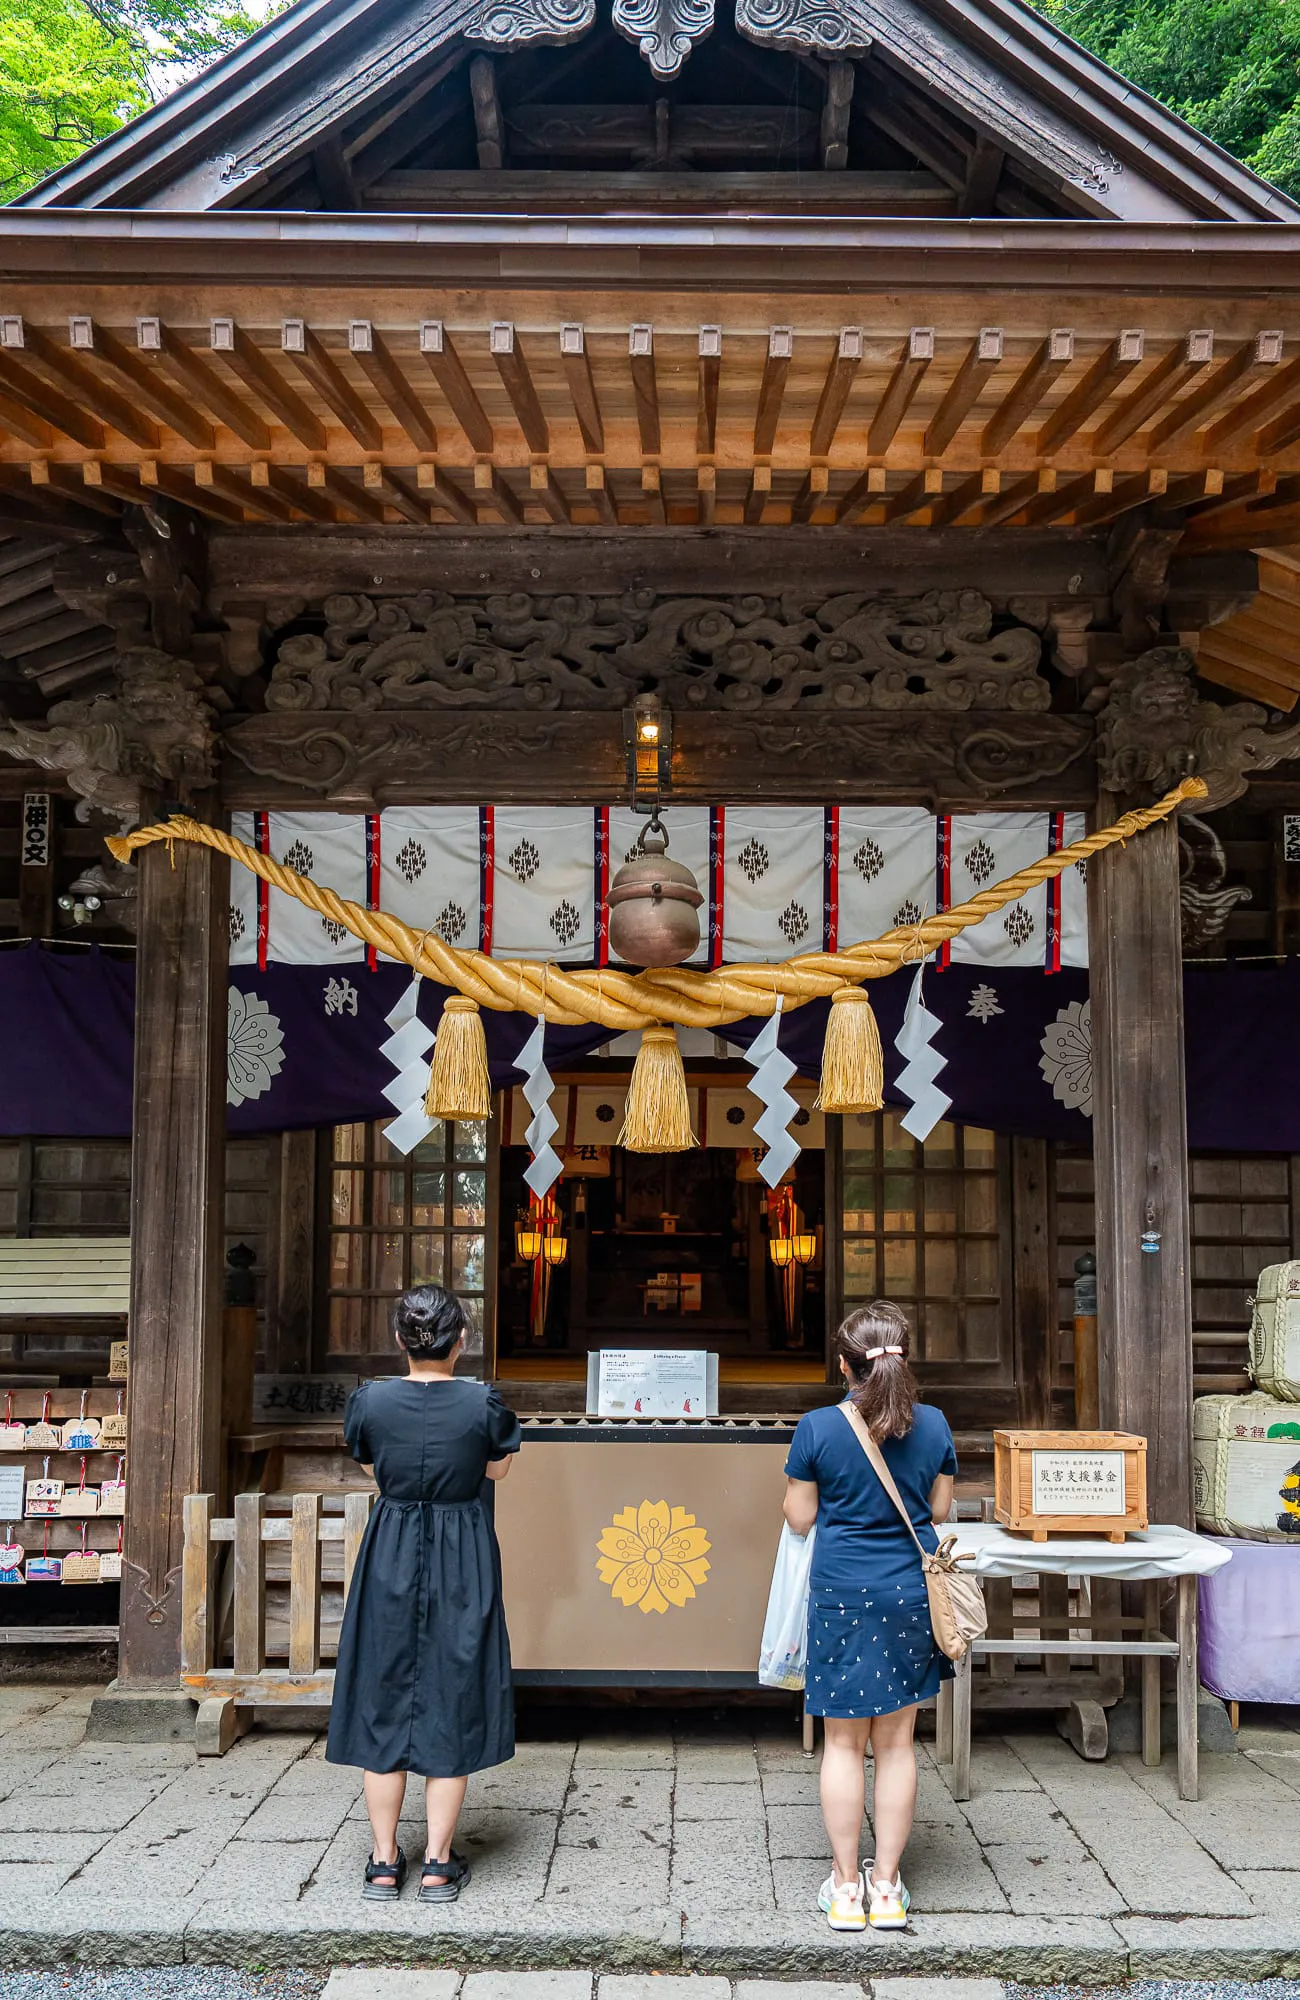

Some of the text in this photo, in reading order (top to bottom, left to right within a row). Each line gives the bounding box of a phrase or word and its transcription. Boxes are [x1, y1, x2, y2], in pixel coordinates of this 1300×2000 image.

[323, 977, 358, 1016] 納
[965, 984, 1005, 1024] 奉
[1233, 1424, 1266, 1439] 登録
[1041, 1469, 1117, 1483] 災害支援募金
